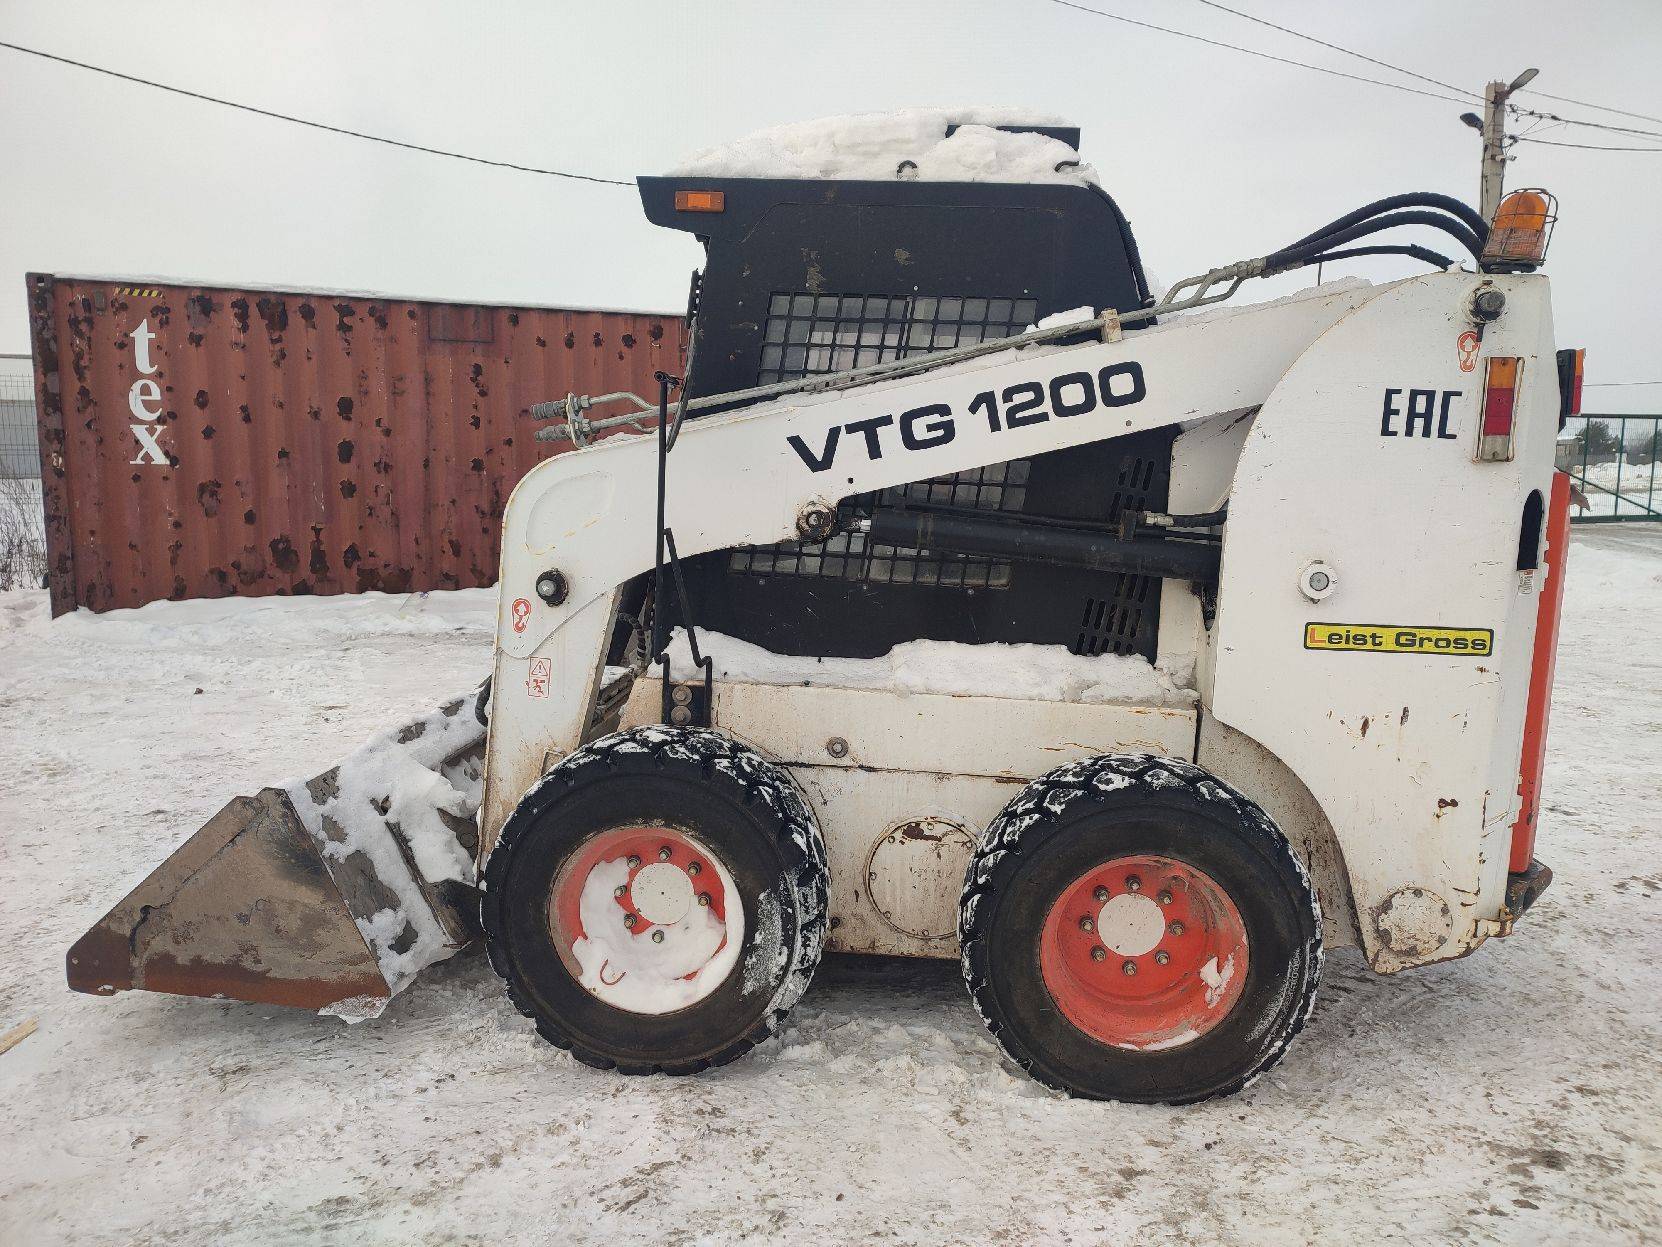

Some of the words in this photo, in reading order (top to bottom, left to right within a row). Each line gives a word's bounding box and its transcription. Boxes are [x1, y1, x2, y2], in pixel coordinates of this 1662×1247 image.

[129, 318, 171, 465] tex
[788, 404, 956, 473] VTG
[968, 361, 1147, 433] 1200
[1380, 388, 1463, 439] EAC
[1309, 627, 1383, 647] Leist
[1394, 631, 1487, 651] Gross
